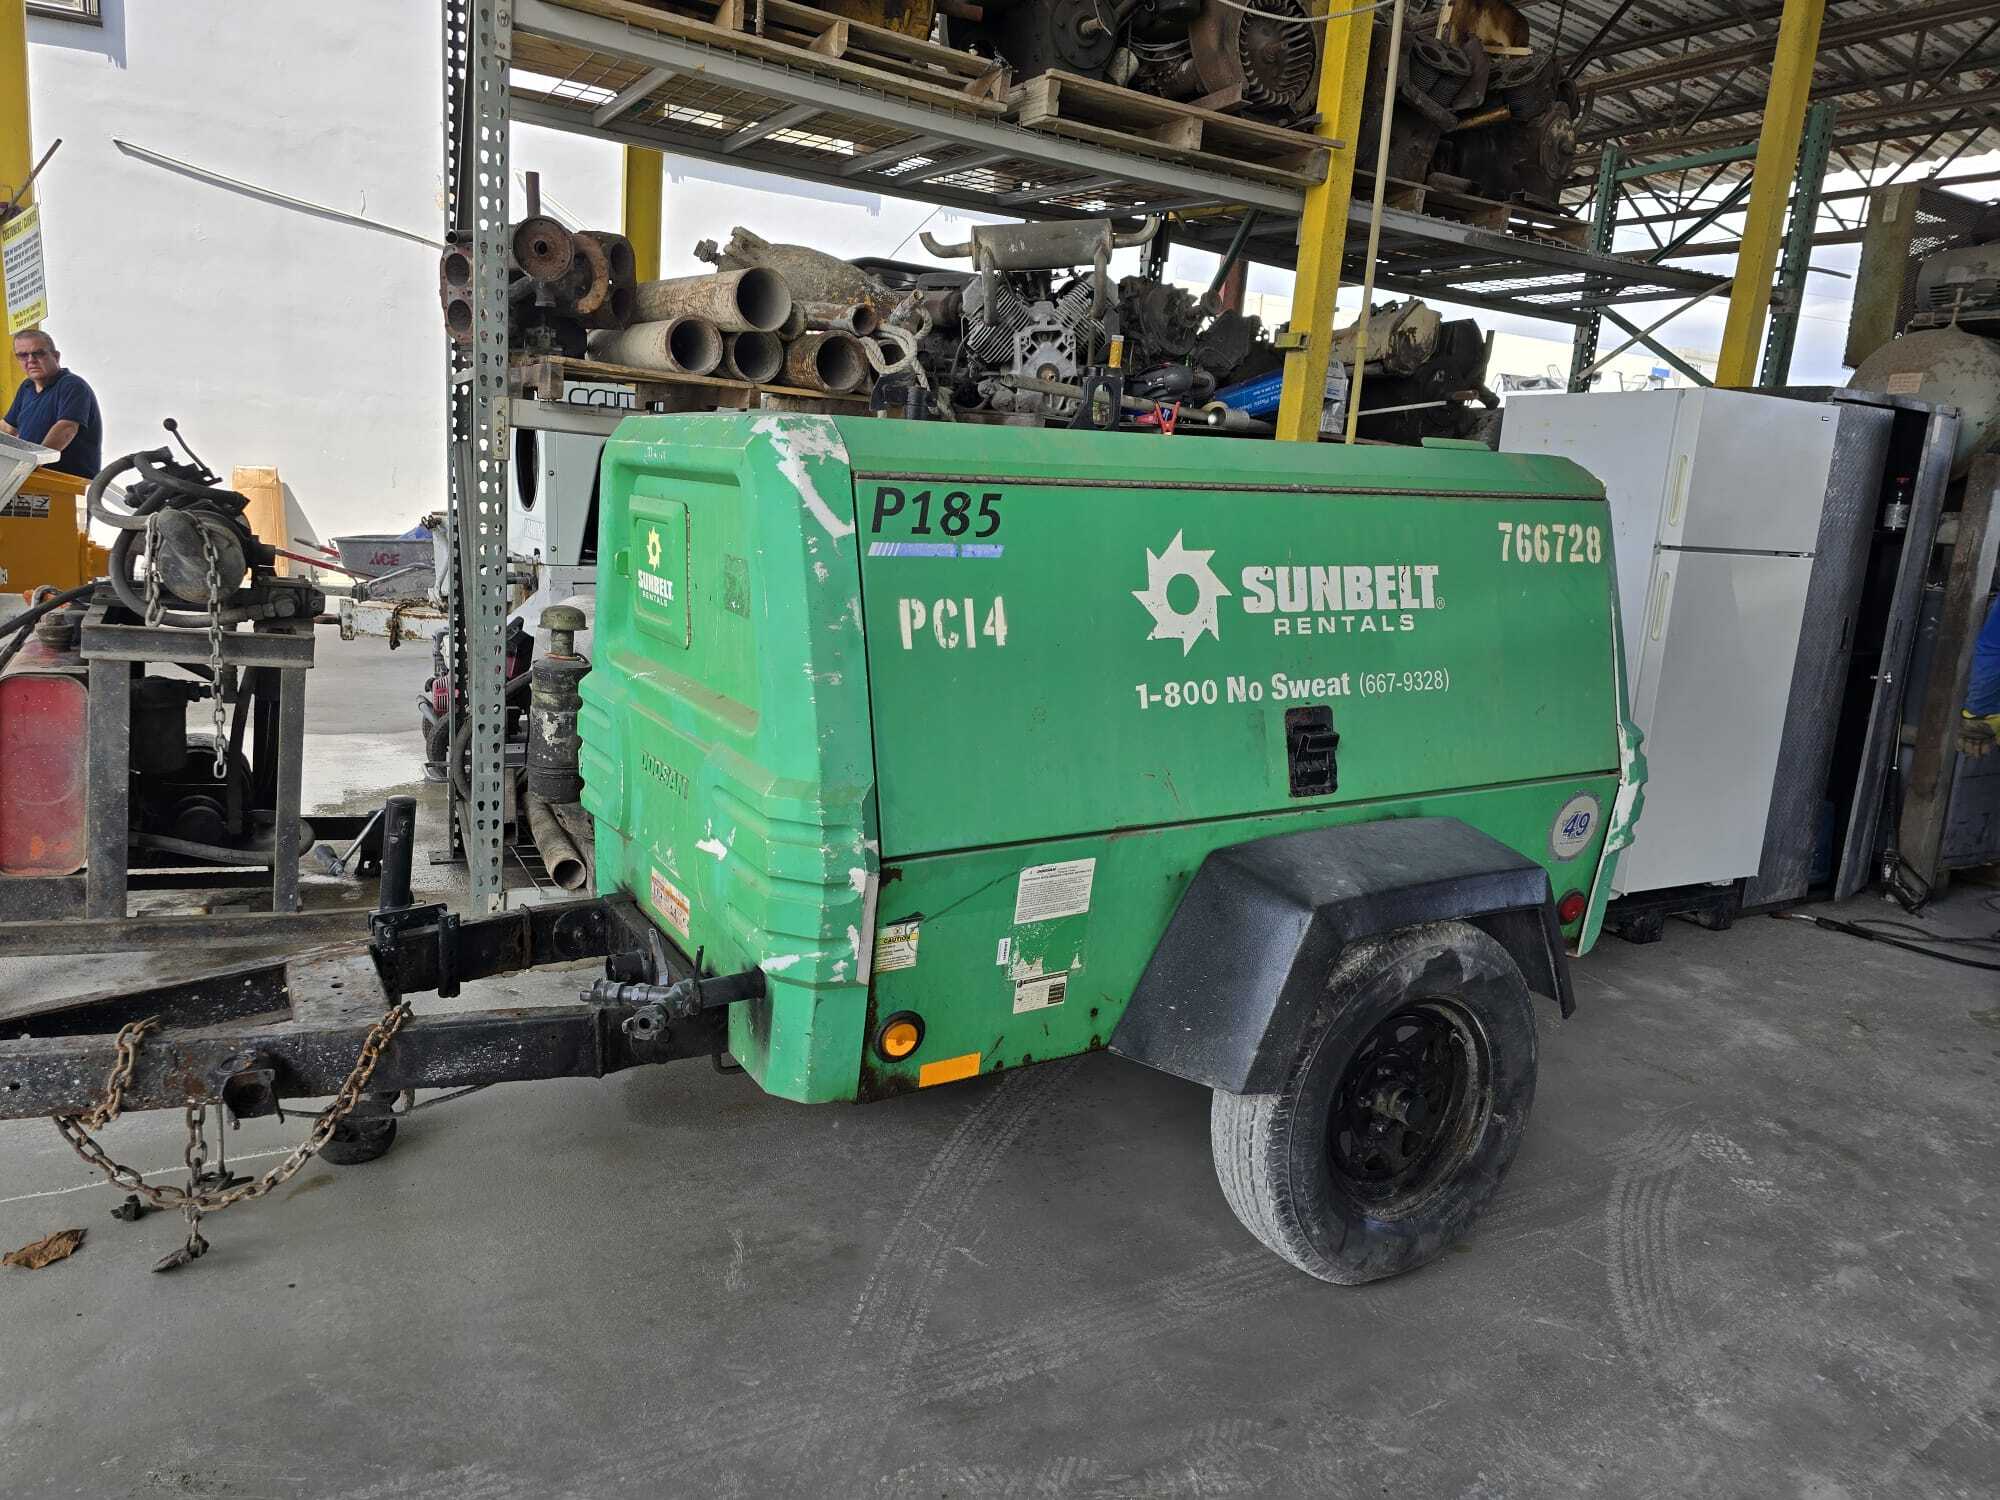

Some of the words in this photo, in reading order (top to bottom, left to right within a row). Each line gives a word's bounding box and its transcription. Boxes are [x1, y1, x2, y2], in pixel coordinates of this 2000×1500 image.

[872, 487, 1002, 538] P185
[1498, 522, 1602, 564] 766728
[369, 552, 400, 567] ACE
[638, 569, 672, 601] SUNBELT
[642, 590, 668, 608] RENTALS
[1241, 564, 1440, 614] SUNBELT
[1274, 613, 1415, 636] RENTALS
[1136, 679, 1218, 710] 1-800
[1226, 675, 1264, 704] No
[1271, 671, 1351, 701] Sweat
[1359, 667, 1450, 698] (667-9328)
[1563, 812, 1591, 837] 49
